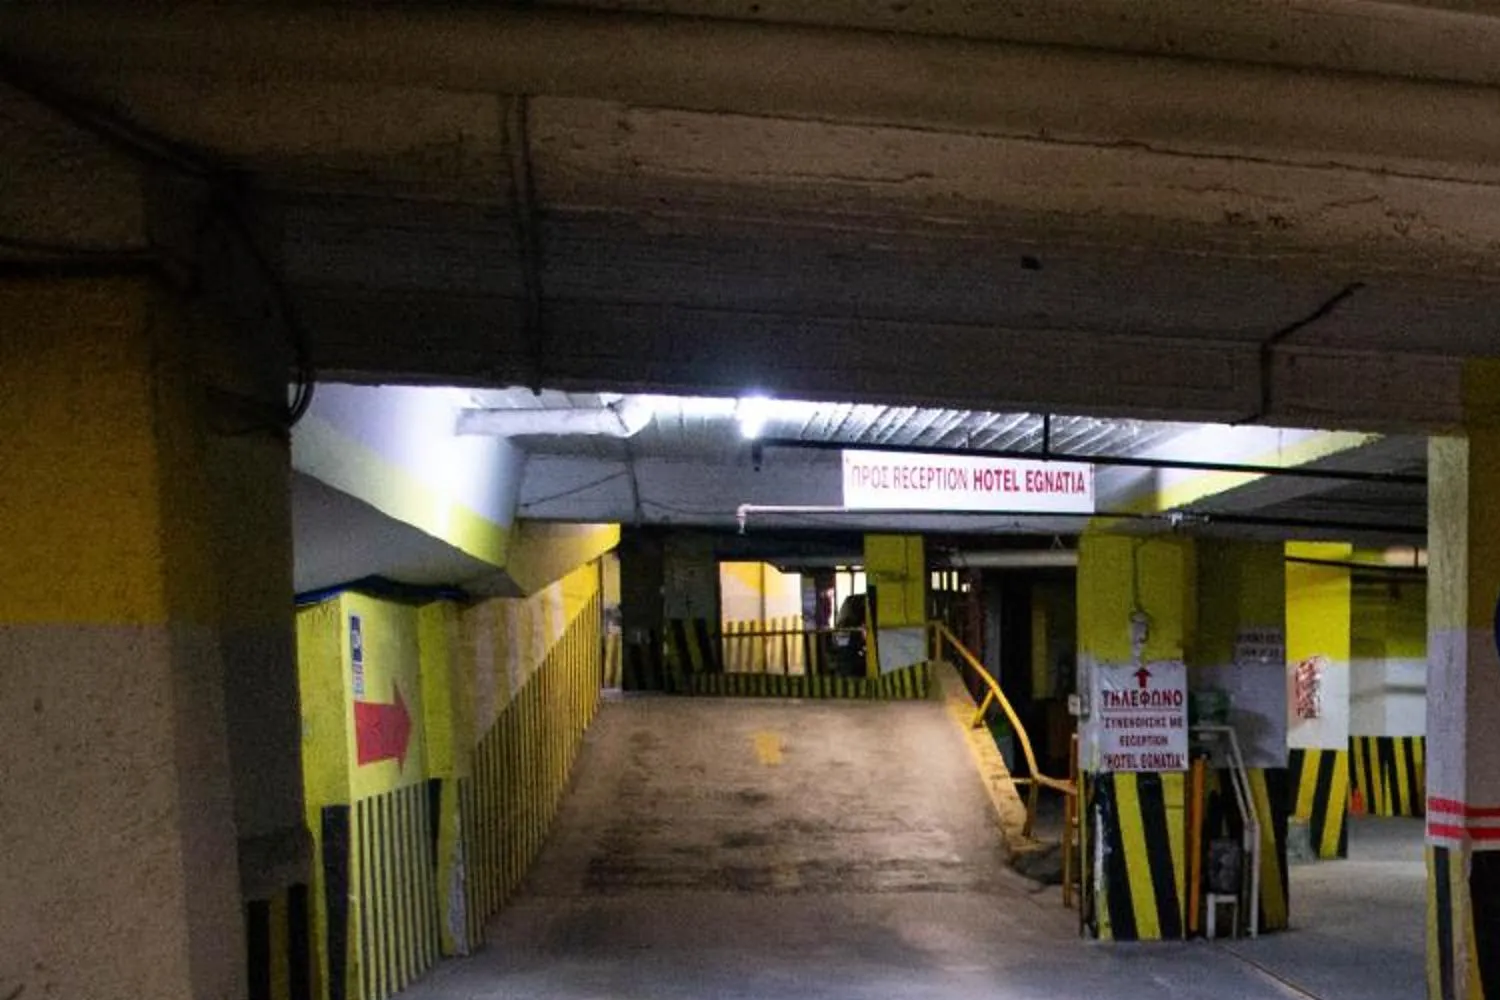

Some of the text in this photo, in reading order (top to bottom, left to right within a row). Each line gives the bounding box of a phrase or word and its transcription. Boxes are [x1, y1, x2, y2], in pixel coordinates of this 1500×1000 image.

[851, 465, 1086, 494] ΠΡΟΣ RECEPTION HOTEL EGNATIA
[1102, 689, 1183, 707] ΤΗΛΕΦΩΝΟ
